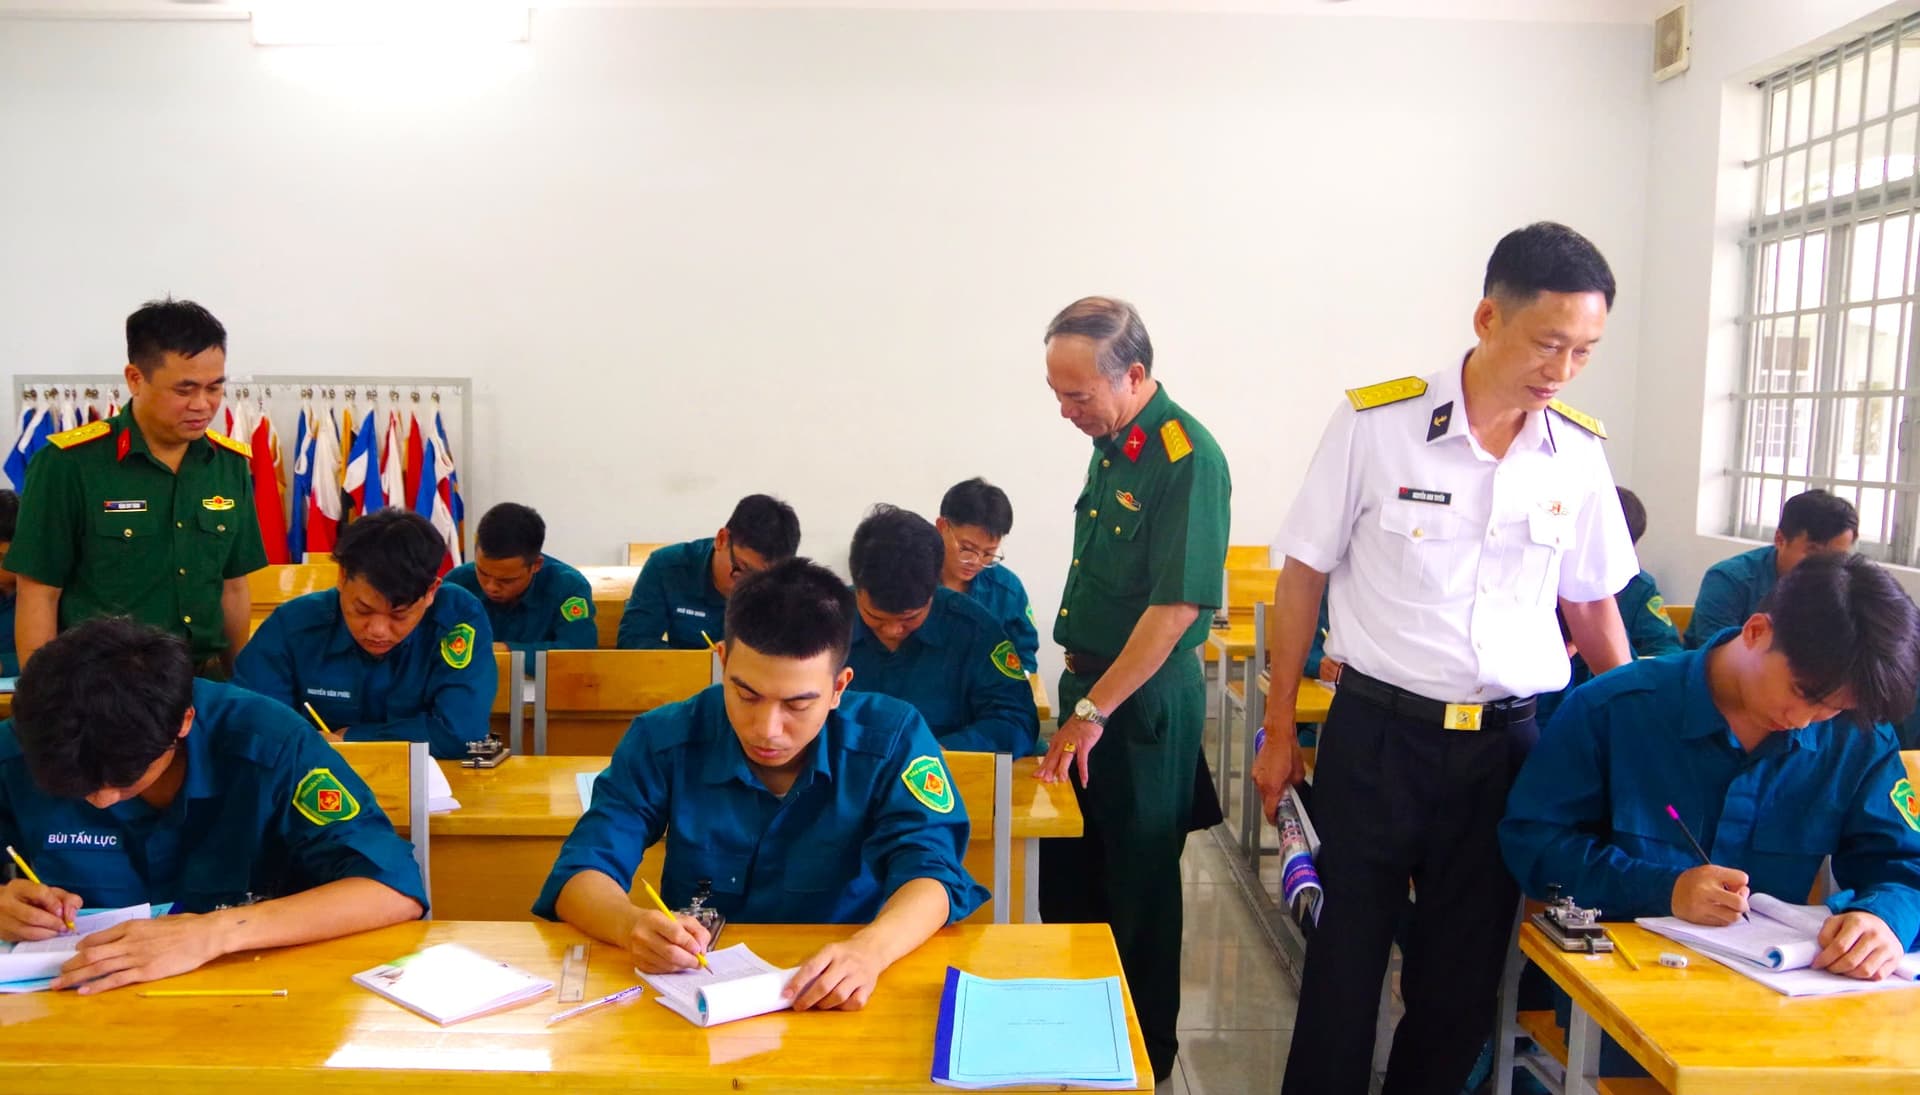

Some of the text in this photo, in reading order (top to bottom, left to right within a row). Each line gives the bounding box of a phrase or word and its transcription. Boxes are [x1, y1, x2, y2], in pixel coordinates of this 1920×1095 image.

[48, 830, 117, 847] BÙI TẤN LỰC
